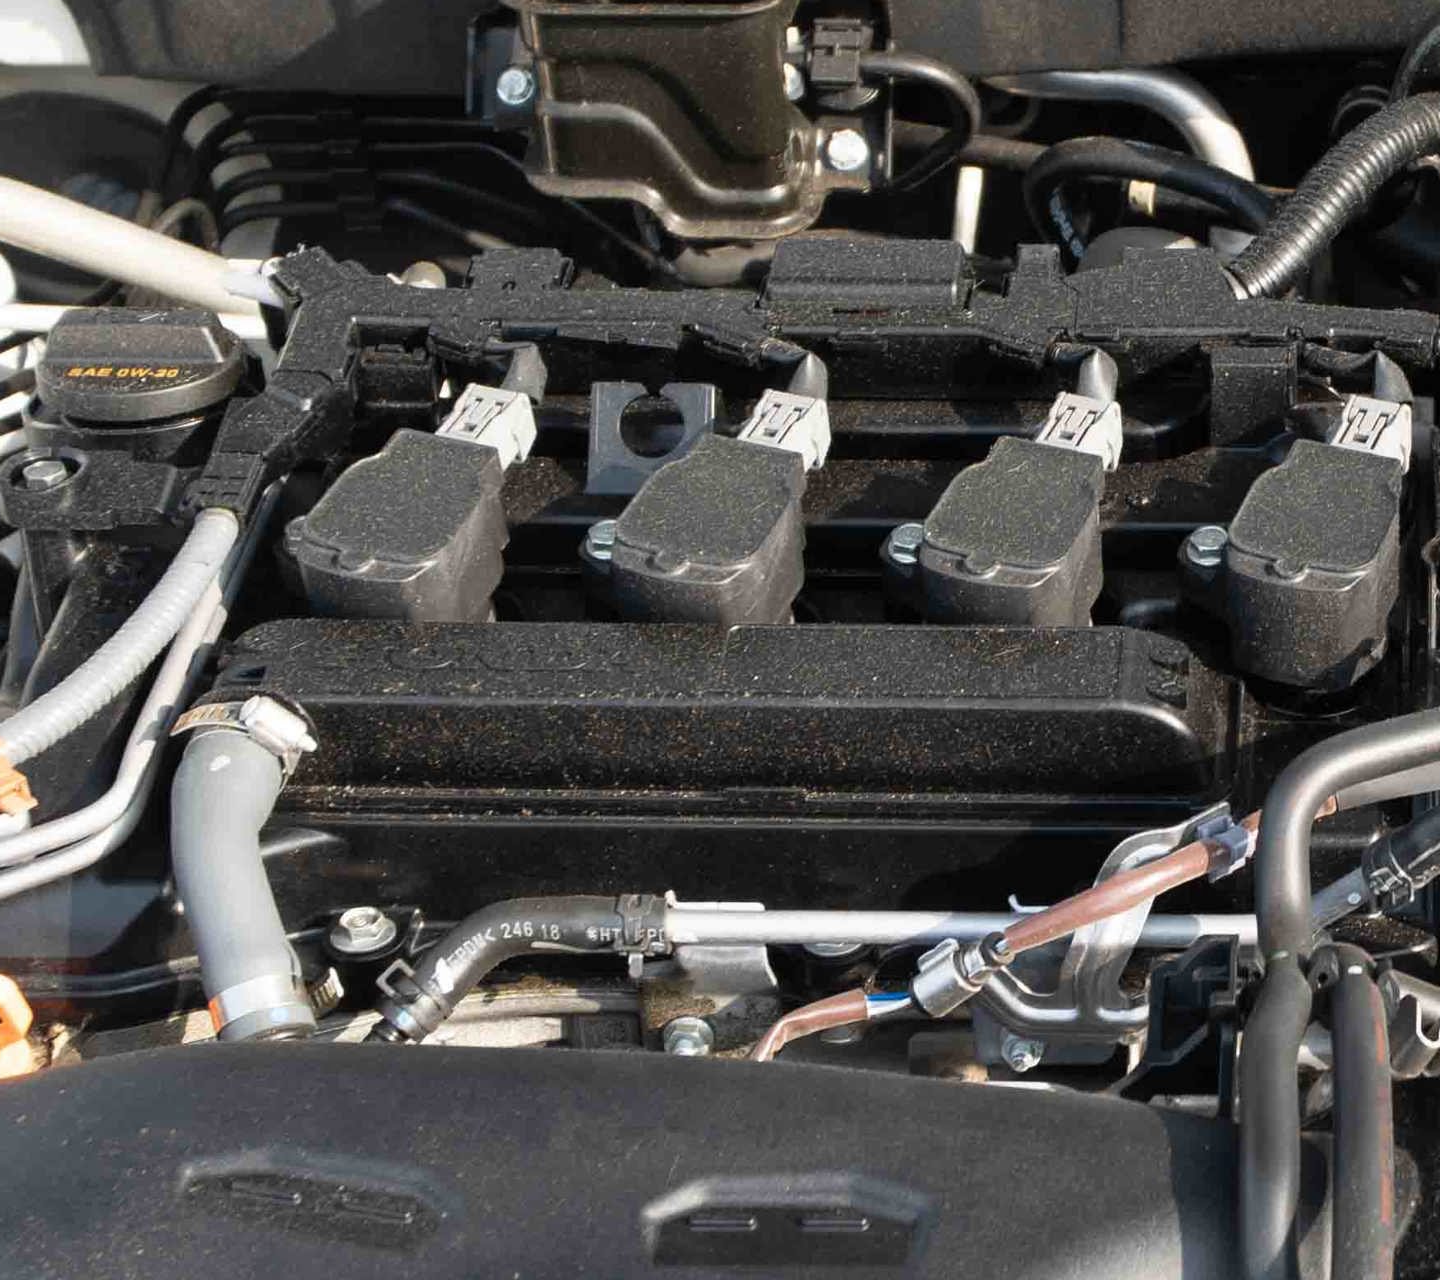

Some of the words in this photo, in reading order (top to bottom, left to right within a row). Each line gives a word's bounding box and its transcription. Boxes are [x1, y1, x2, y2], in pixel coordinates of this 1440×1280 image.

[67, 366, 113, 377] SAE
[116, 366, 179, 378] 0W-20
[498, 919, 534, 939] 246
